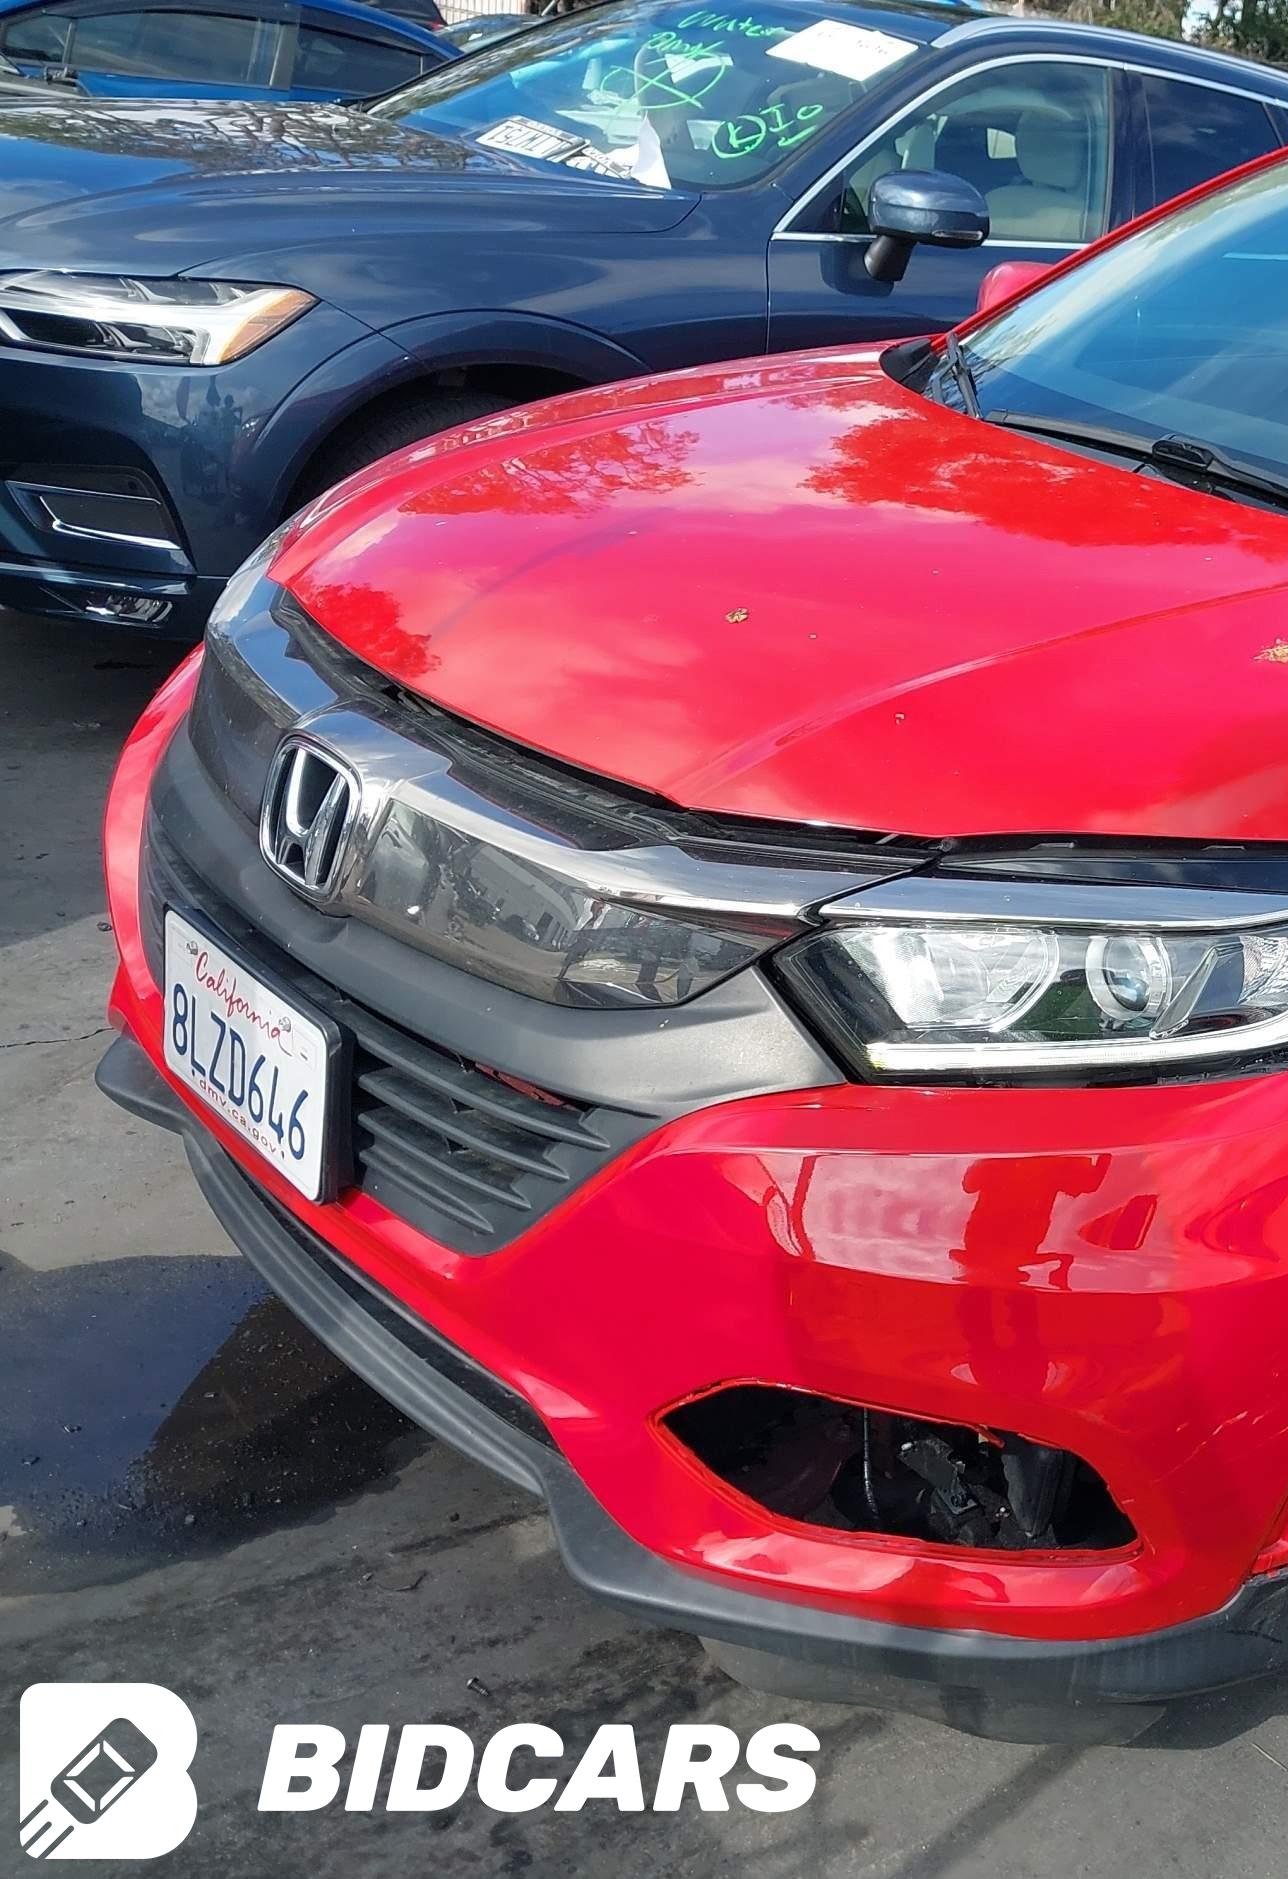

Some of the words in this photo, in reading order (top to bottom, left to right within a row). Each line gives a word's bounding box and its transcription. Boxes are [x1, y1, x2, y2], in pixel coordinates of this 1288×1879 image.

[195, 950, 292, 1057] California
[172, 983, 309, 1160] 8LZD646
[199, 1077, 278, 1155] dmv.ca.gov
